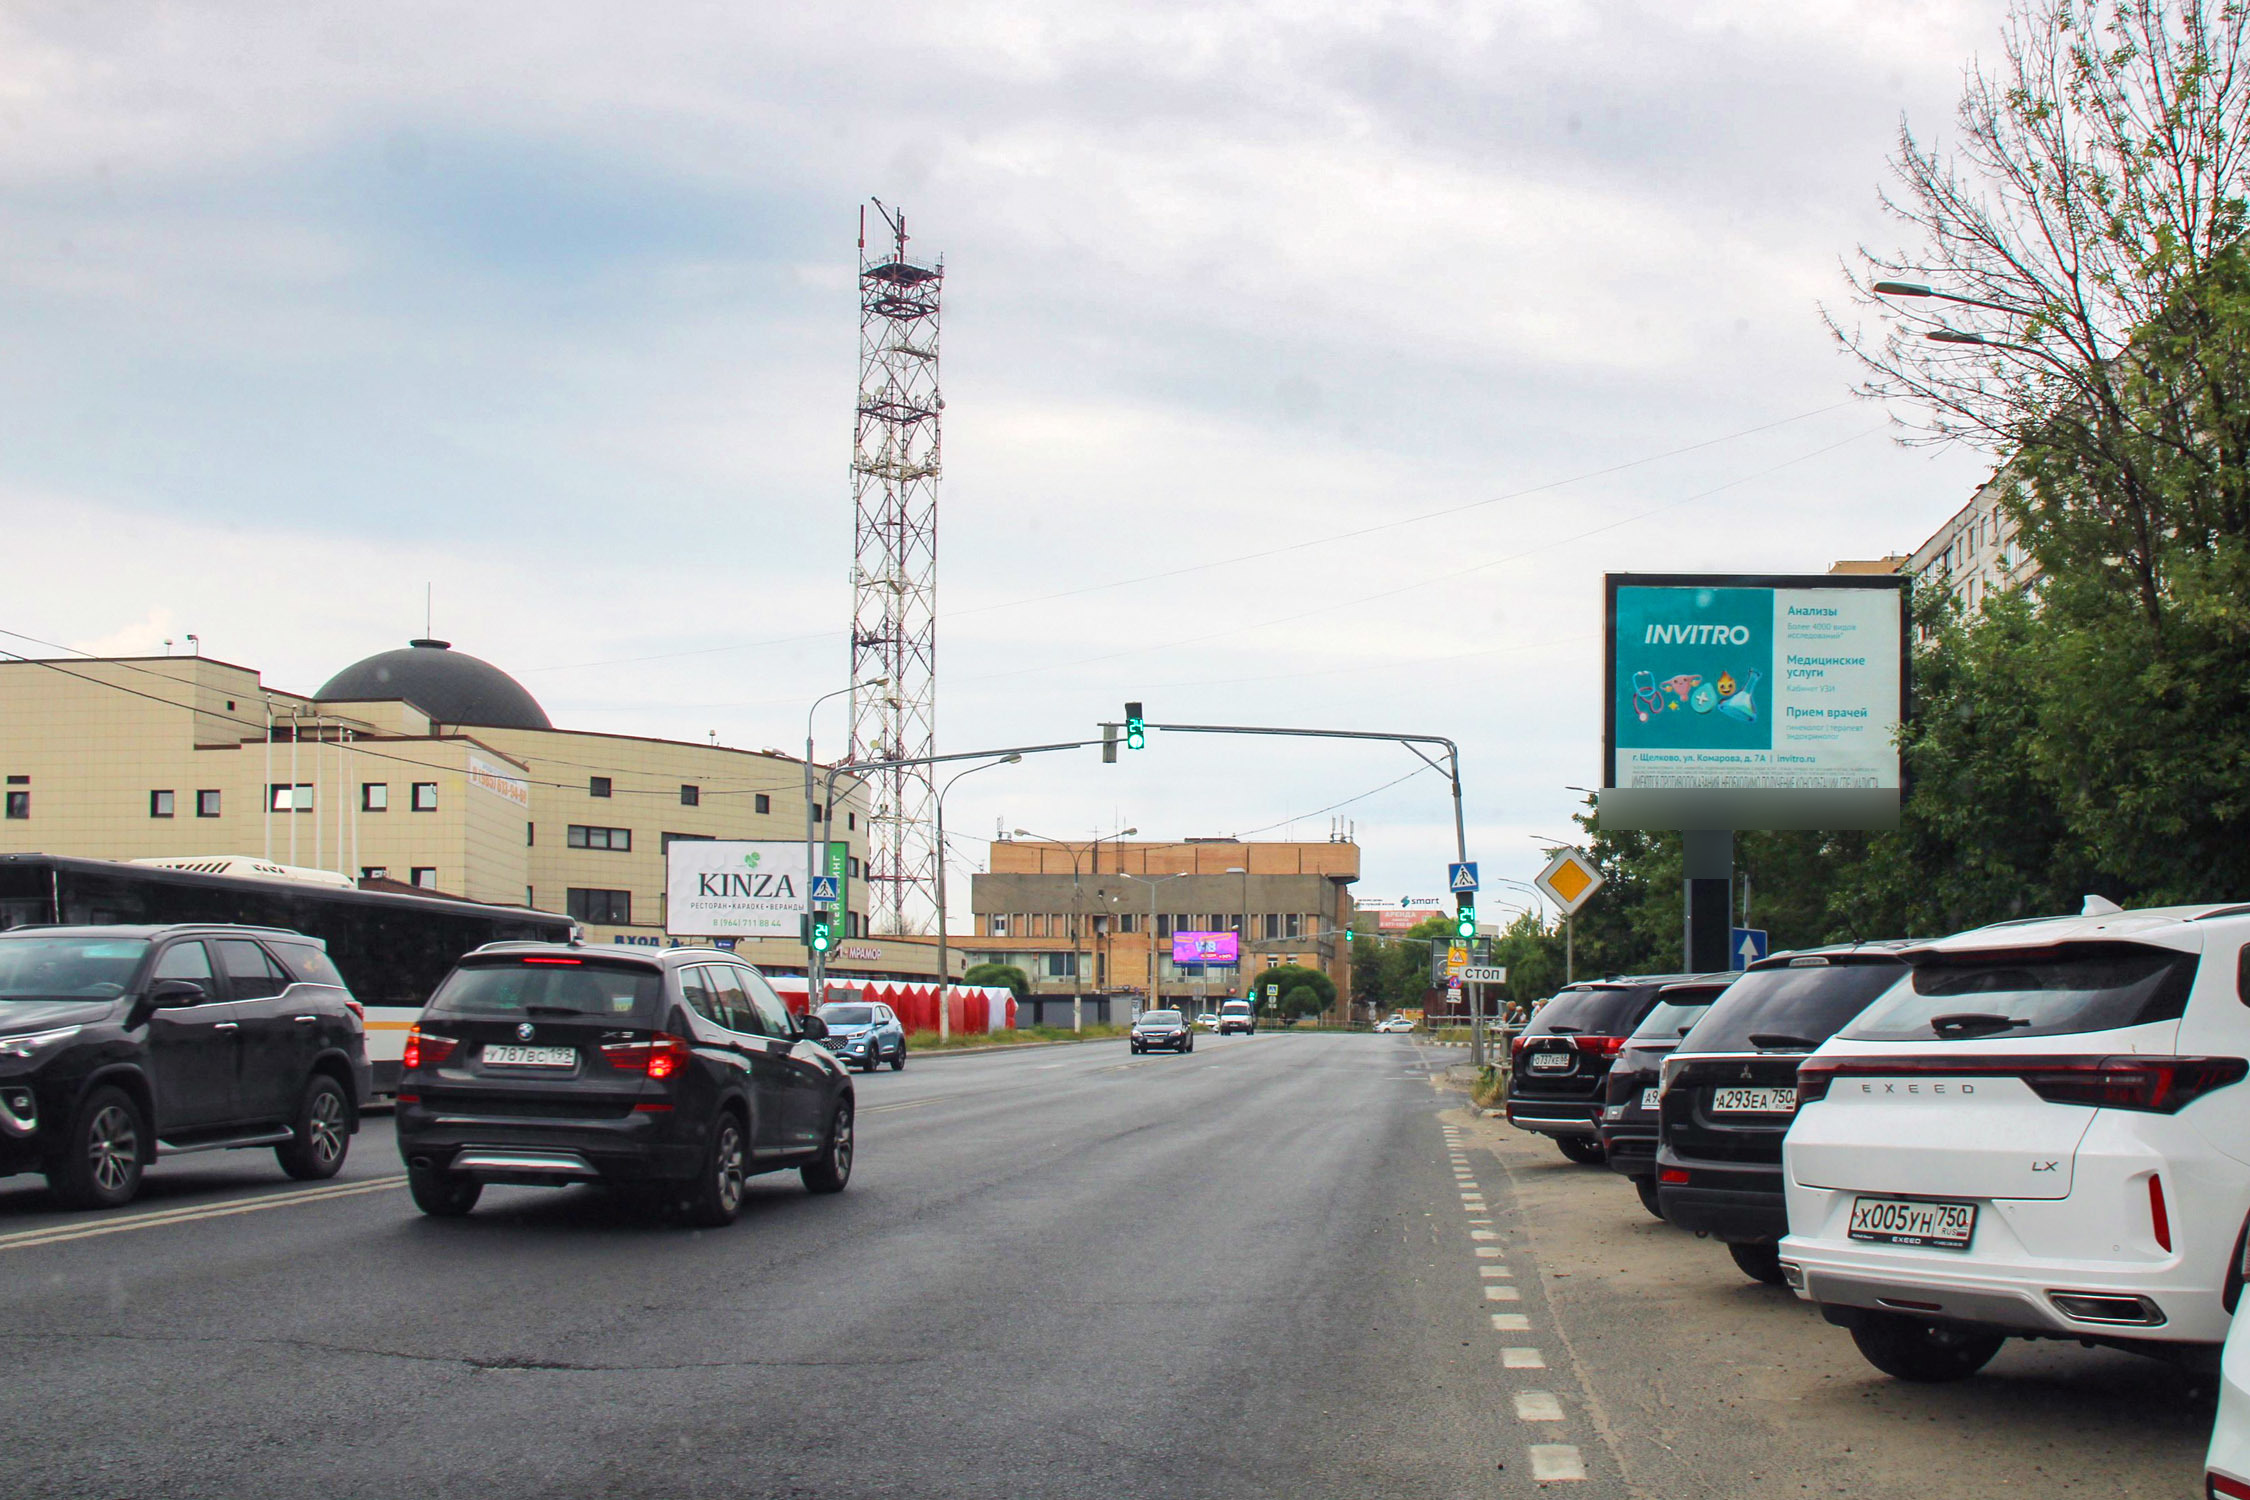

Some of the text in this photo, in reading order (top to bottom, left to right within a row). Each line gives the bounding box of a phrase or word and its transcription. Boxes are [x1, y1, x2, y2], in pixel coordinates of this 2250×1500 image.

[1787, 606, 1838, 616] Анализы
[1812, 623, 1832, 631] 4000
[1644, 624, 1750, 645] INVITRO
[1786, 654, 1866, 666] Медицинские
[1786, 669, 1824, 679] услуги
[1820, 685, 1836, 693] УЗИ
[1786, 706, 1868, 720] Прием врачей
[1129, 718, 1144, 733] 24
[1639, 753, 1682, 763] Щелково,
[1683, 754, 1696, 764] ул.
[1696, 753, 1743, 764] Комарова,
[1777, 753, 1816, 763] invitro.ru
[698, 872, 796, 898] KINZA
[690, 902, 729, 910] РЕСТОРАН
[770, 903, 805, 911] ВЕРАНДЫ
[1411, 897, 1440, 905] smart
[1460, 907, 1474, 921] 24
[720, 919, 740, 927] (964)
[743, 919, 757, 927] 711
[759, 919, 769, 927] 88
[771, 919, 782, 927] 44
[815, 924, 829, 937] 24
[614, 935, 660, 947] ВХОД
[848, 946, 882, 960] МРАМОР
[1464, 968, 1500, 980] СТОП
[1861, 1084, 1975, 1094] EXEED
[1645, 1090, 1660, 1104] А9
[1772, 1089, 1793, 1104] 750
[2031, 1161, 2058, 1172] LX
[1937, 1206, 1967, 1228] 750
[1941, 1227, 1957, 1236] RUS
[1891, 1236, 1921, 1245] EXEED
